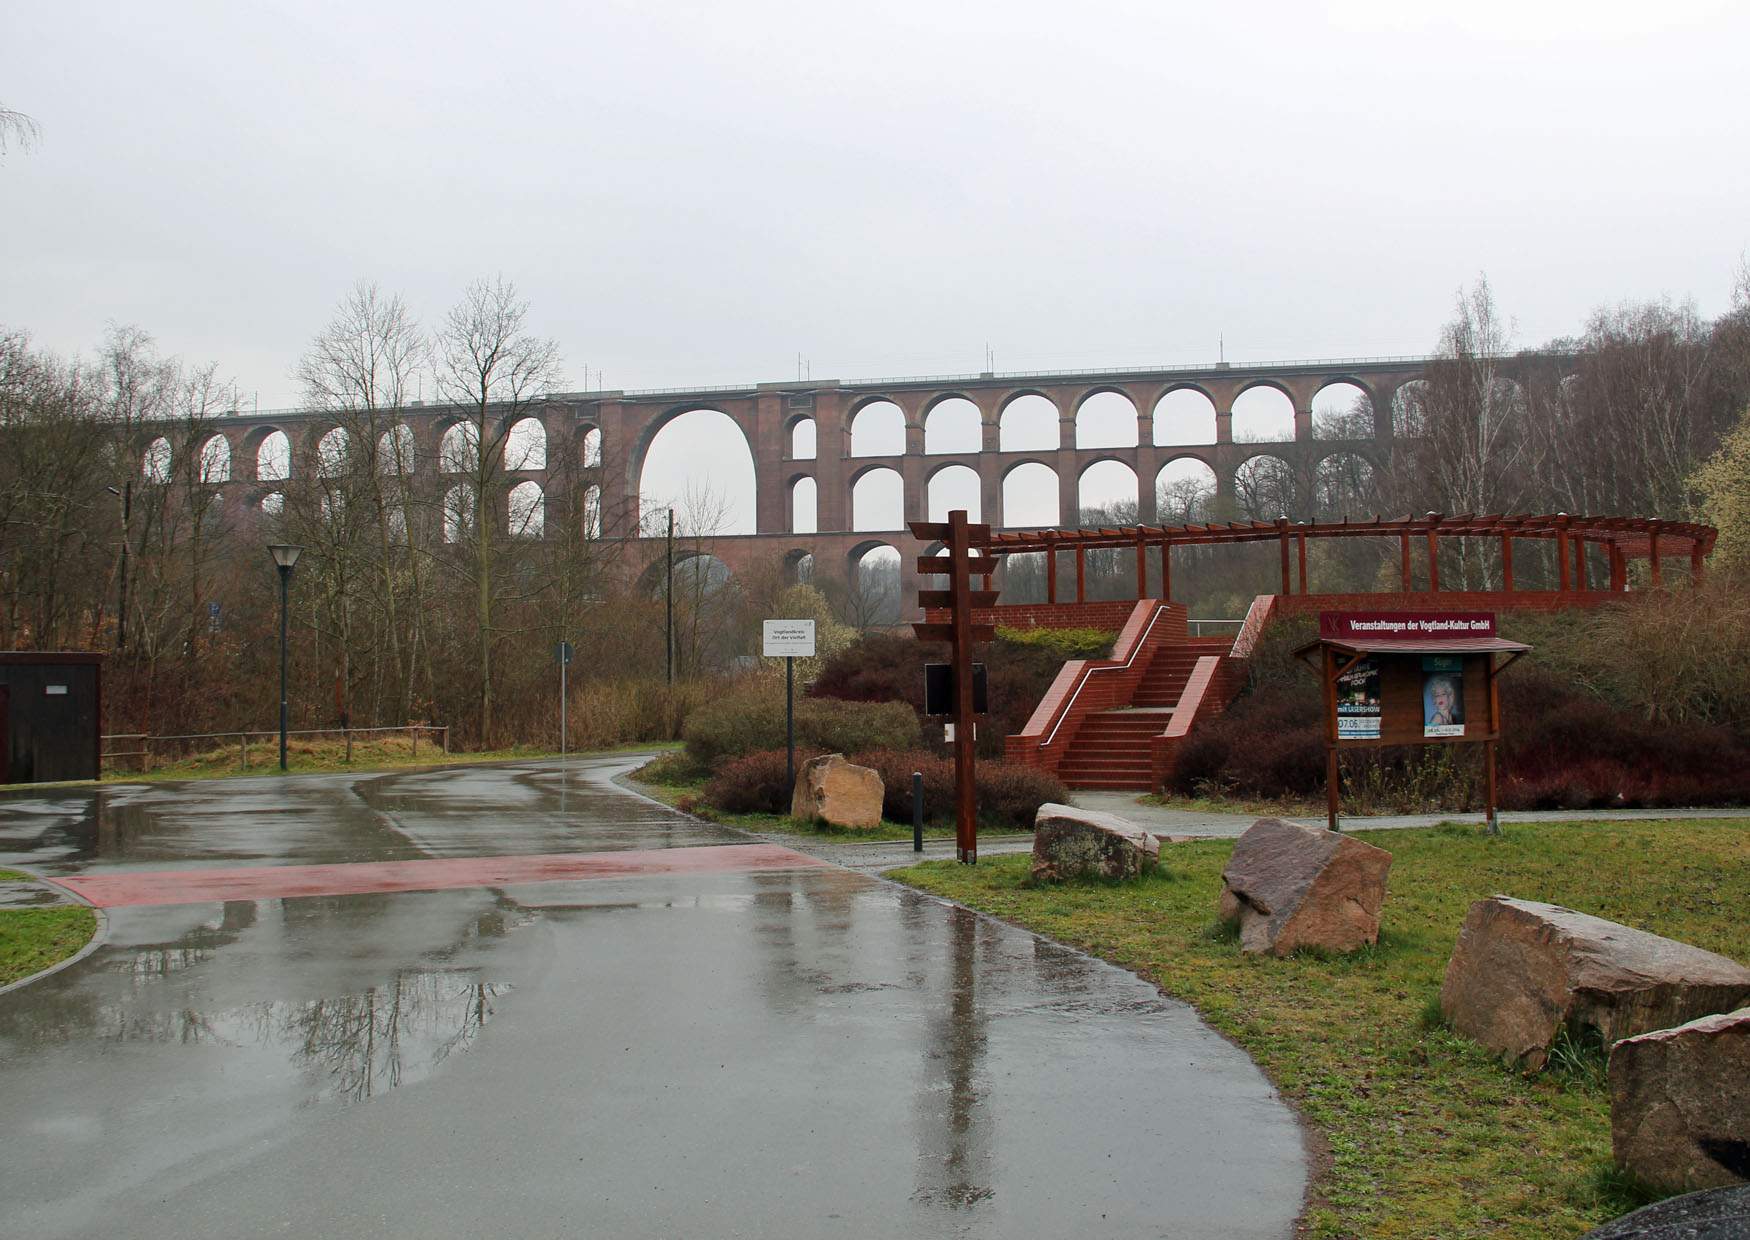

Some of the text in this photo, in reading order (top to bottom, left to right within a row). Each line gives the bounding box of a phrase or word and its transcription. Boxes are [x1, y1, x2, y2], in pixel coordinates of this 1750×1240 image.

[1350, 620, 1490, 632] Veranstaltungen der Vogtland-Kultur GmbH
